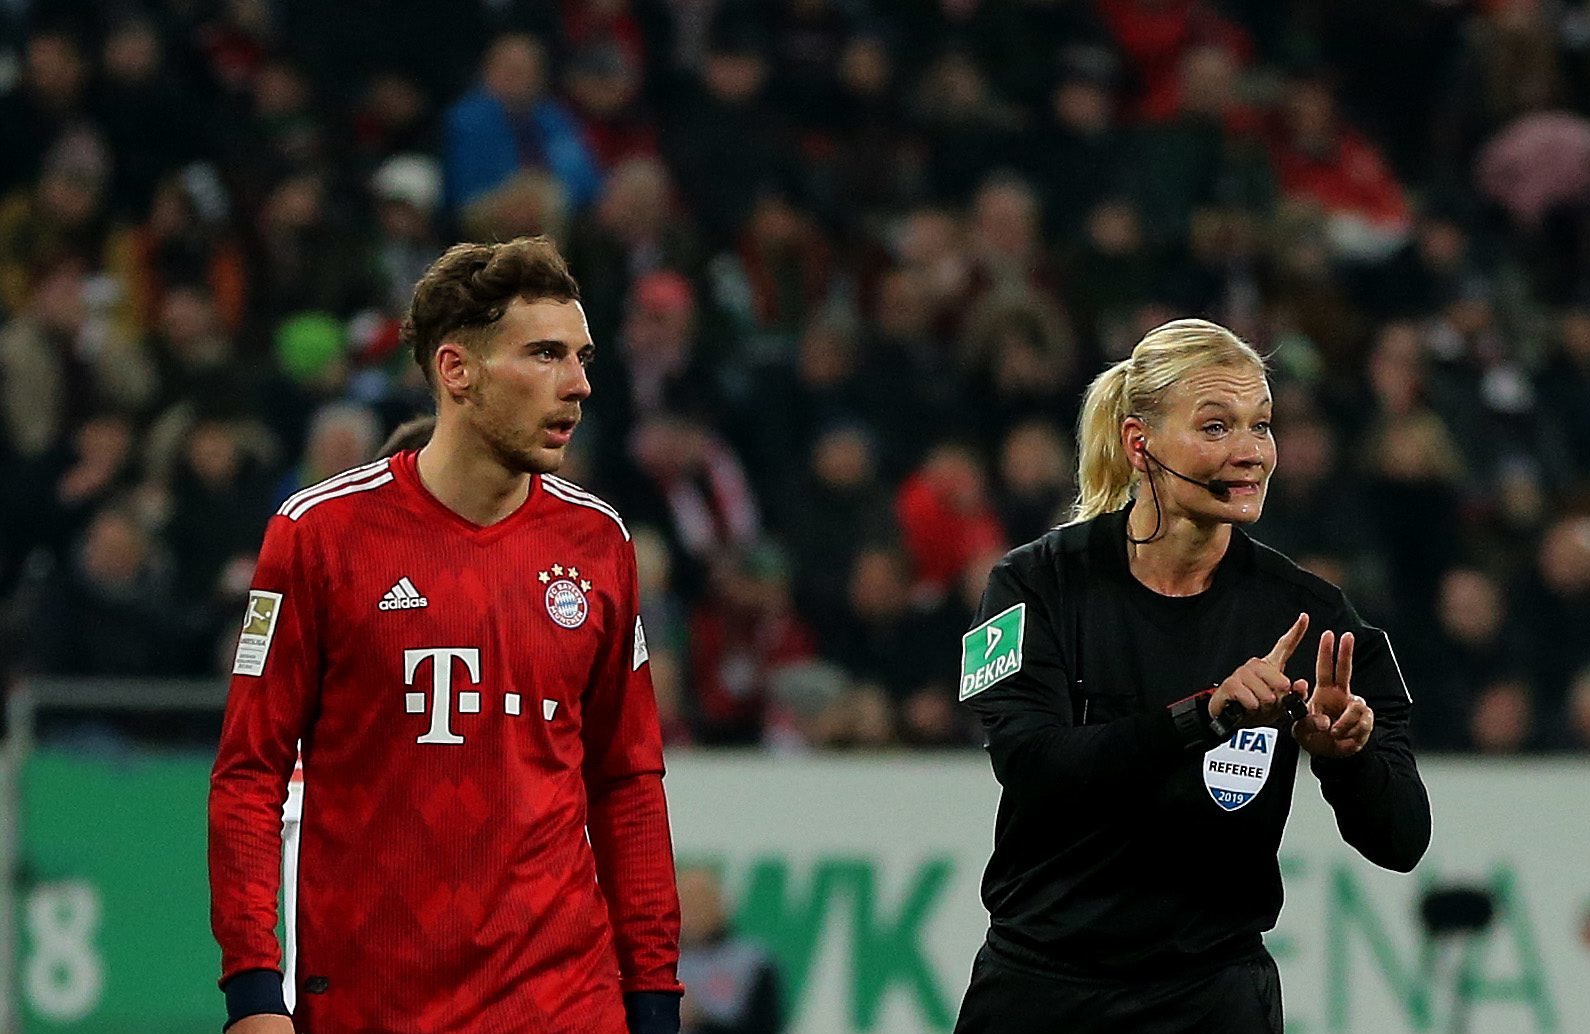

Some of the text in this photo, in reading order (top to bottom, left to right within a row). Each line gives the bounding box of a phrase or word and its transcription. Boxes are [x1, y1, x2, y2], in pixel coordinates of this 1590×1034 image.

[378, 596, 428, 611] adidas
[962, 648, 1018, 697] DEKRA
[1208, 760, 1264, 779] REFEREE
[1218, 791, 1244, 804] 2019
